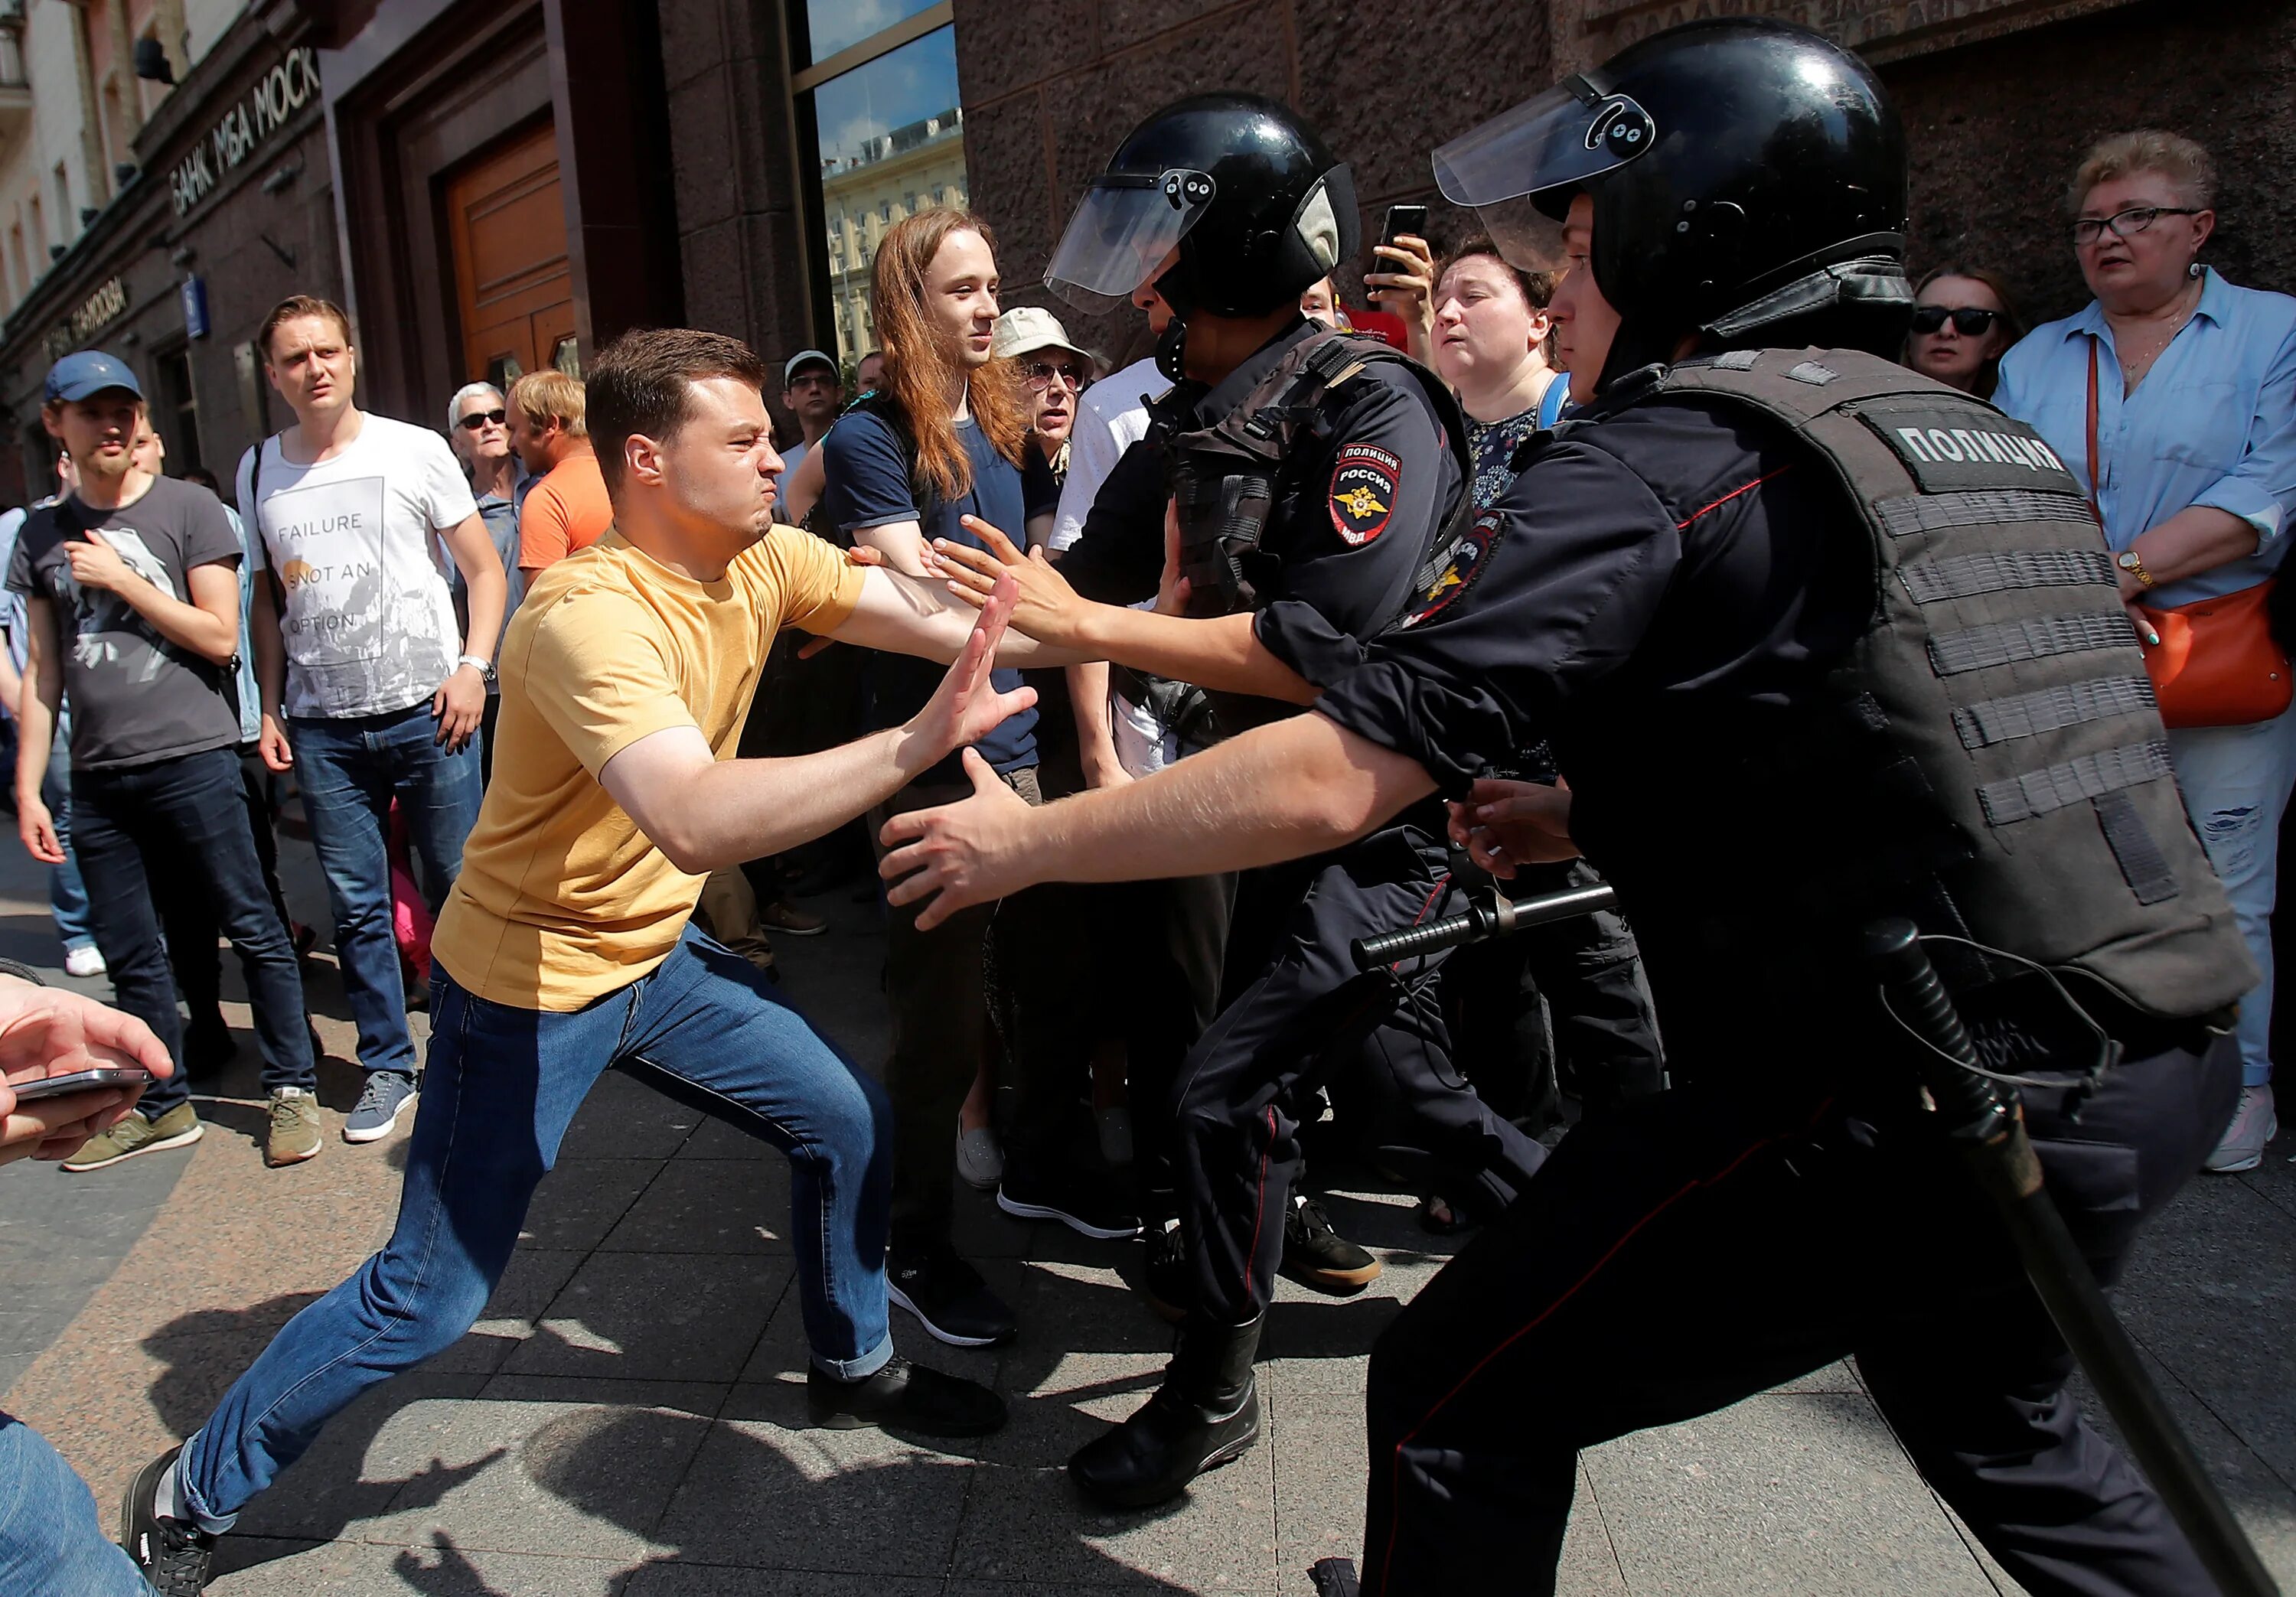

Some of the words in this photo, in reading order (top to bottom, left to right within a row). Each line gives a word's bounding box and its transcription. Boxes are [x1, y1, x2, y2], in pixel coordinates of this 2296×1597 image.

[169, 139, 214, 216] БАНК
[213, 101, 254, 175] МБА
[253, 47, 320, 139] МОСК
[1345, 448, 1397, 471] ПОЛИЦИЯ
[1896, 428, 2066, 471] ПОЛИЦИЯ
[1339, 469, 1391, 494] РОССИЯ
[278, 513, 362, 543] FAILURE
[1342, 526, 1365, 544] МВД
[297, 566, 333, 584] NOT
[341, 562, 370, 579] AN
[290, 613, 354, 634] OPTION
